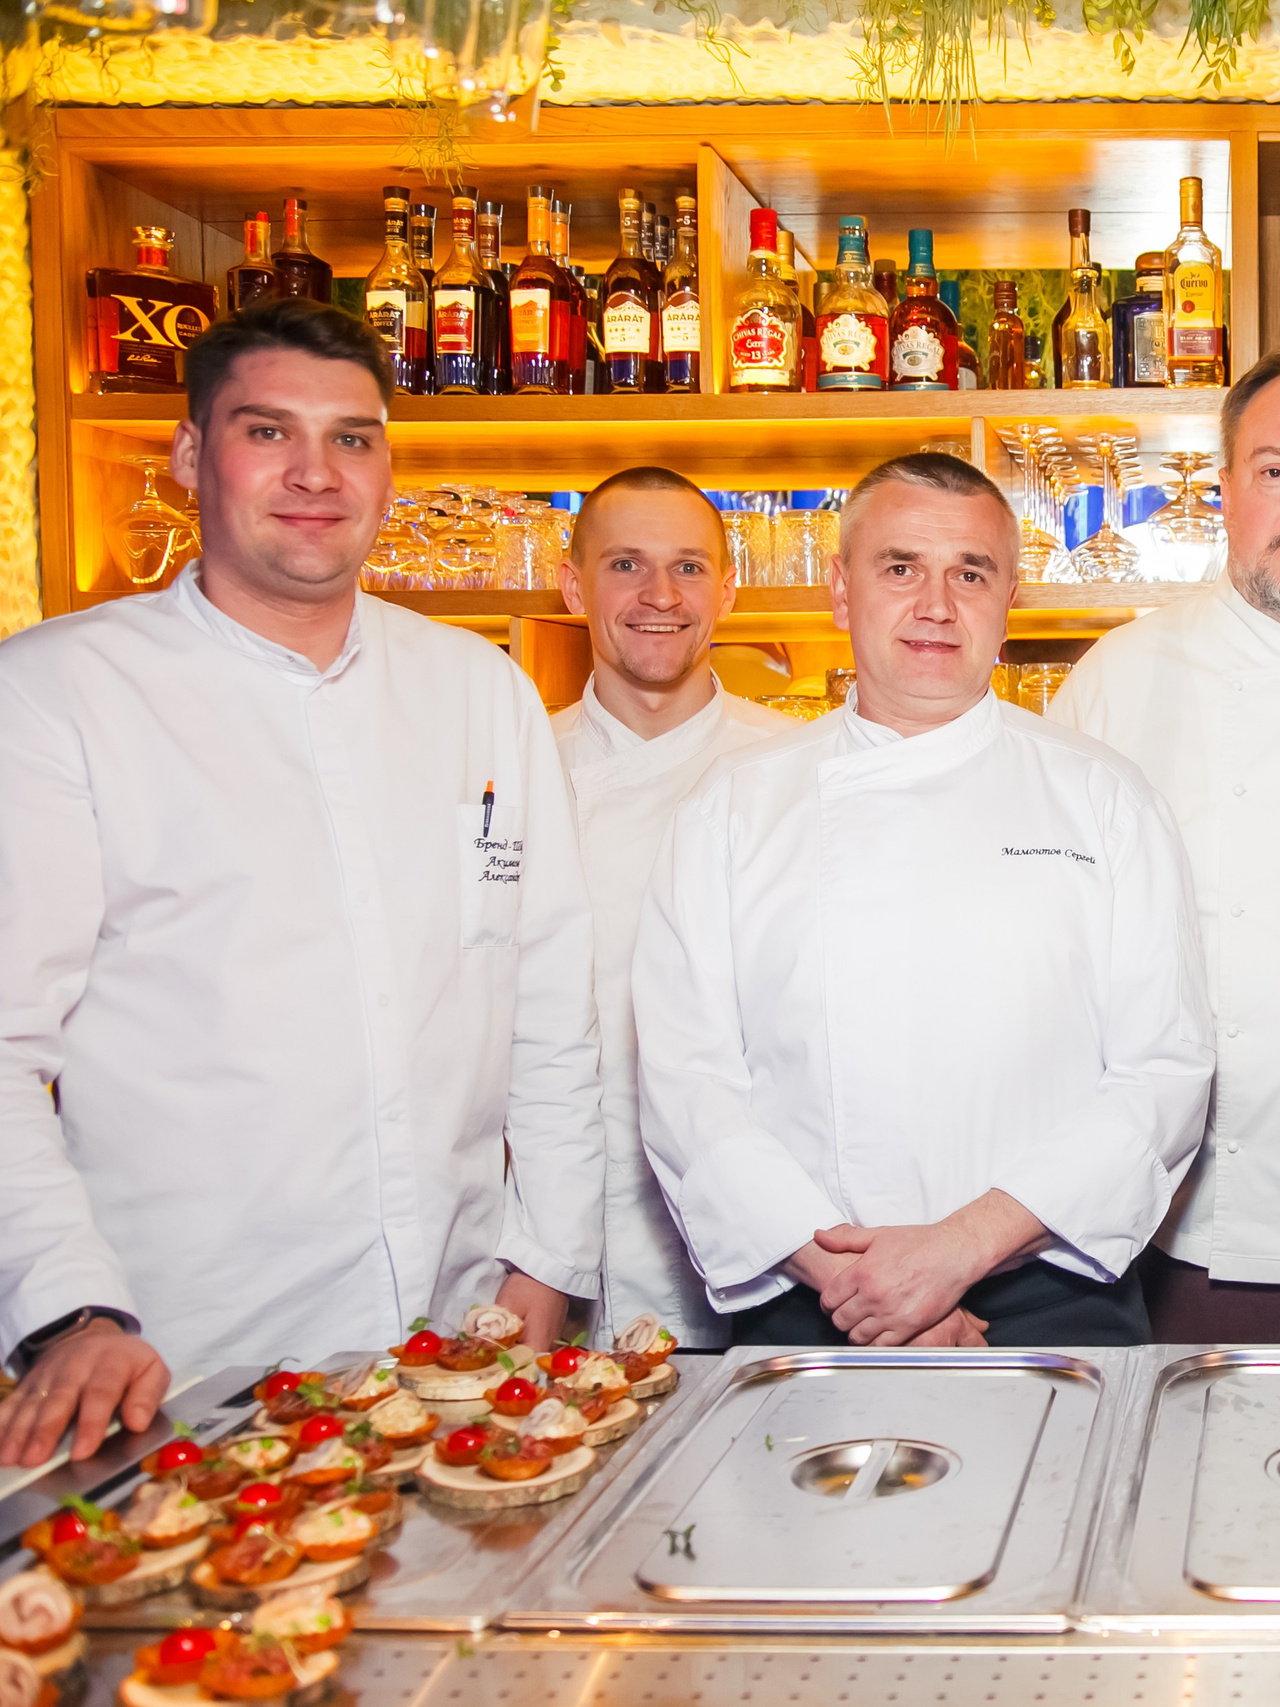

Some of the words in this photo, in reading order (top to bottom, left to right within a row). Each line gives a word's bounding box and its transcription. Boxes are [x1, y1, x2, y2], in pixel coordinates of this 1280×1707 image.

[1180, 277, 1208, 290] Cuervo
[369, 310, 401, 319] ARARAT
[438, 310, 470, 319] ARARAT
[606, 313, 645, 323] ARARAT
[666, 312, 700, 322] ARARA
[110, 294, 211, 350] XO
[733, 328, 756, 342] CHIVAS
[757, 327, 782, 341] REGAL
[821, 330, 846, 345] CHIVAS
[848, 330, 873, 343] REGAL
[916, 341, 941, 356] REGAL
[1001, 847, 1062, 856] Мамонтов
[1065, 848, 1096, 864] Сергей
